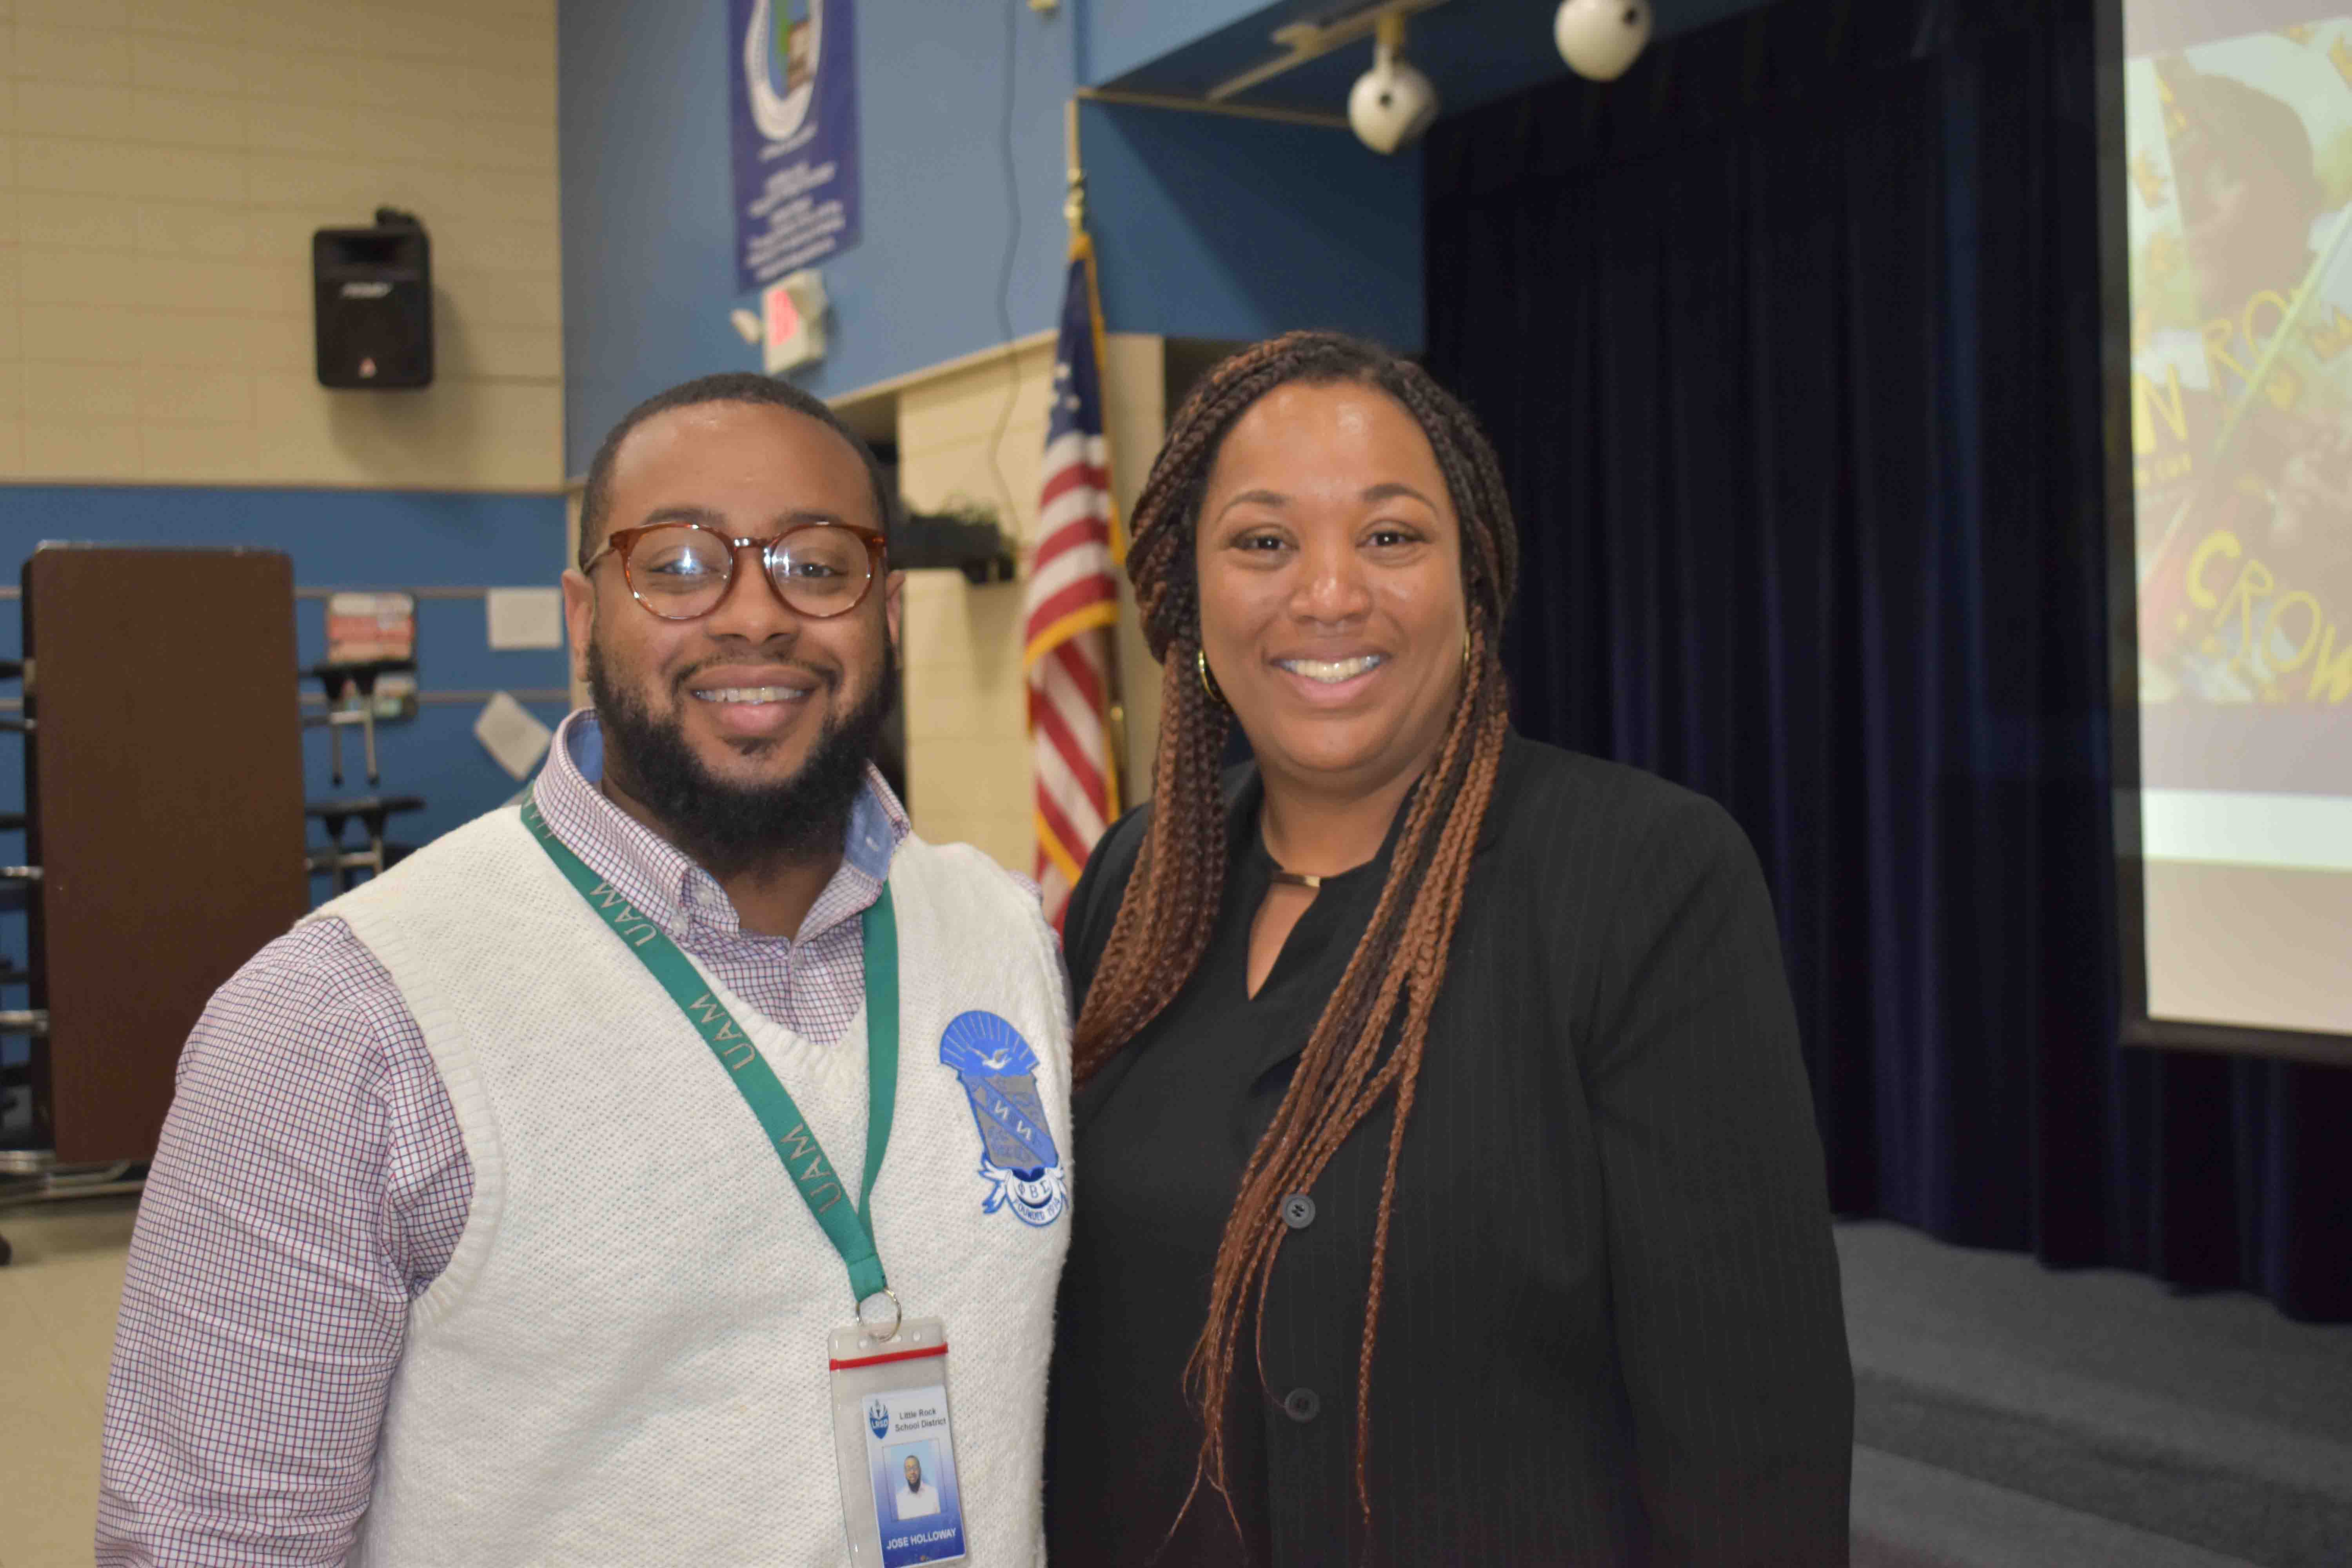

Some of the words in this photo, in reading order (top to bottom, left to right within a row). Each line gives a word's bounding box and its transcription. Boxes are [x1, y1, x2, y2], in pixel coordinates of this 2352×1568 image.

[589, 882, 657, 947] UAM
[689, 993, 756, 1071] UAM
[779, 1122, 842, 1214] UAM
[895, 1422, 920, 1432] School
[922, 1417, 946, 1428] District
[899, 1411, 917, 1420] Little
[919, 1407, 937, 1418] Rock
[886, 1536, 909, 1550] JOSE
[910, 1528, 956, 1546] HOLLOWAY
